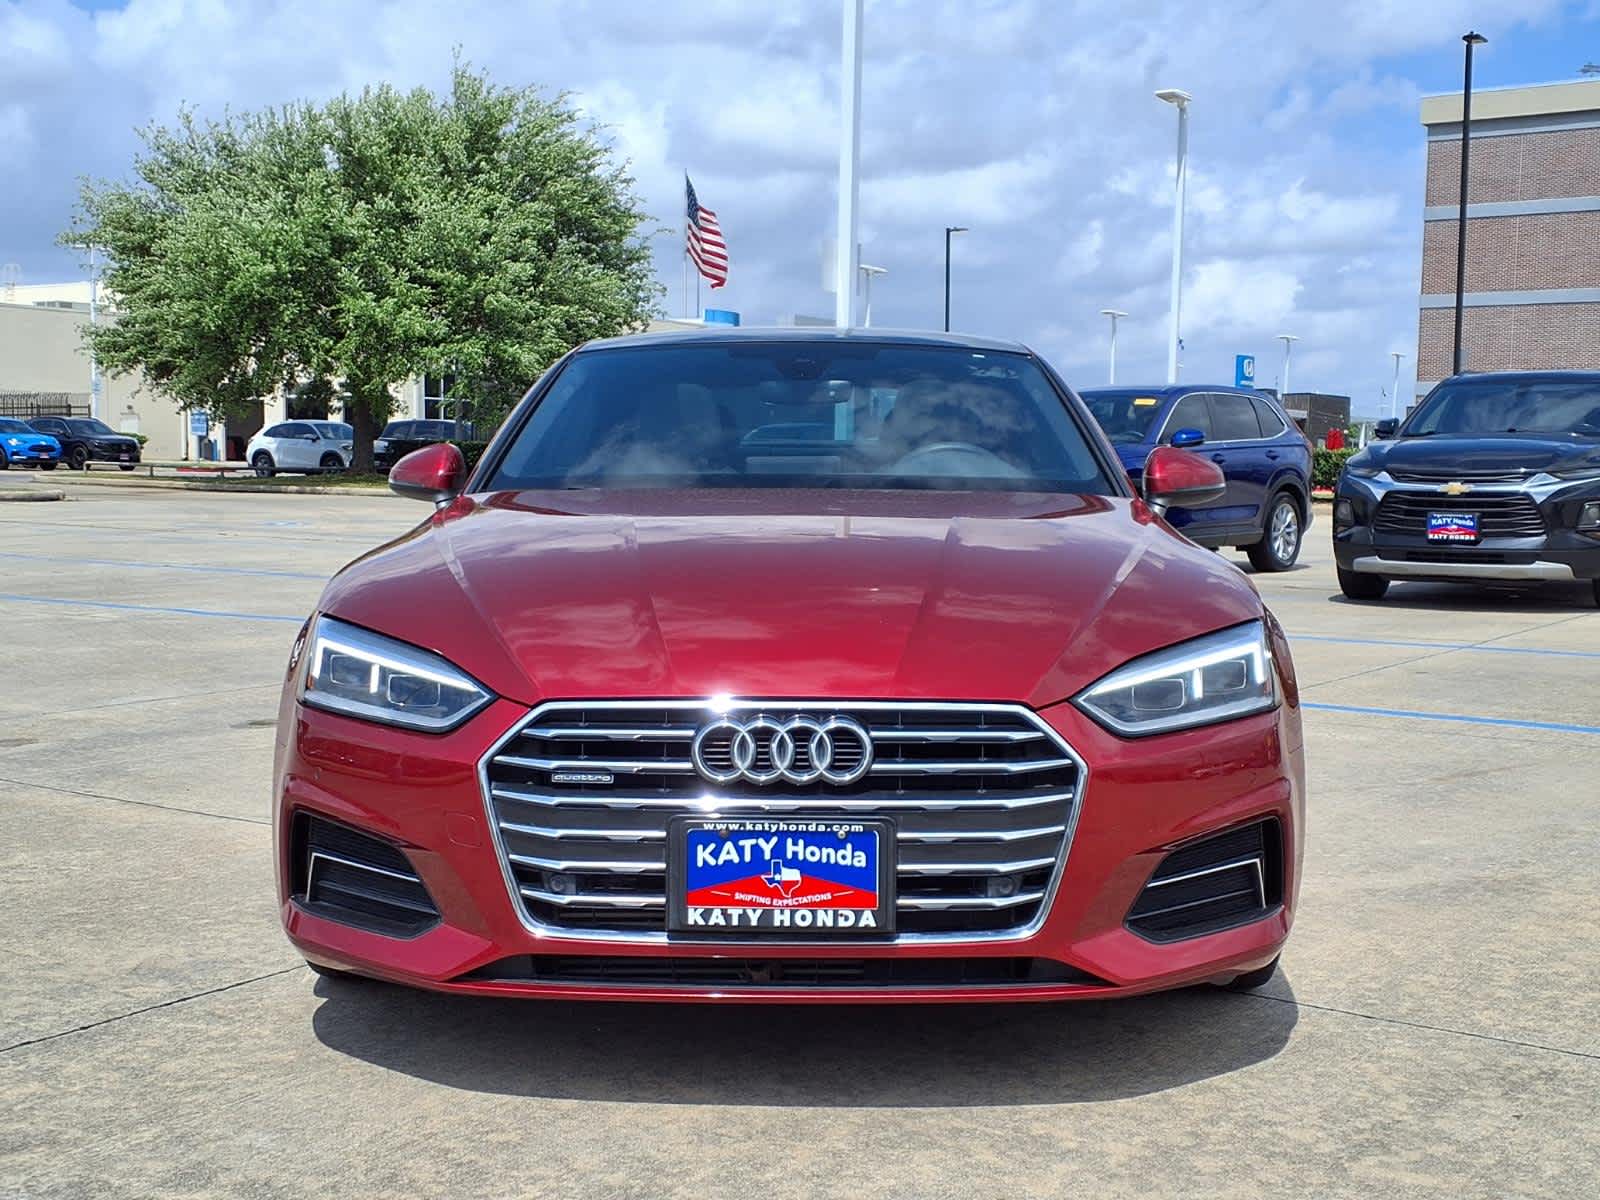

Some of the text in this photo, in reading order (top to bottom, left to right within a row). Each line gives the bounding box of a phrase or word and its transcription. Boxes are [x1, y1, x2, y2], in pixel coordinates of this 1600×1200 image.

[1431, 518, 1452, 526] KATY
[554, 774, 611, 783] quattro
[703, 821, 864, 833] www.katyhonda.com
[696, 836, 867, 868] KATY Honda
[734, 892, 832, 907] SHIFTING EXPECTATIONS
[687, 908, 877, 928] KATY HONDA
